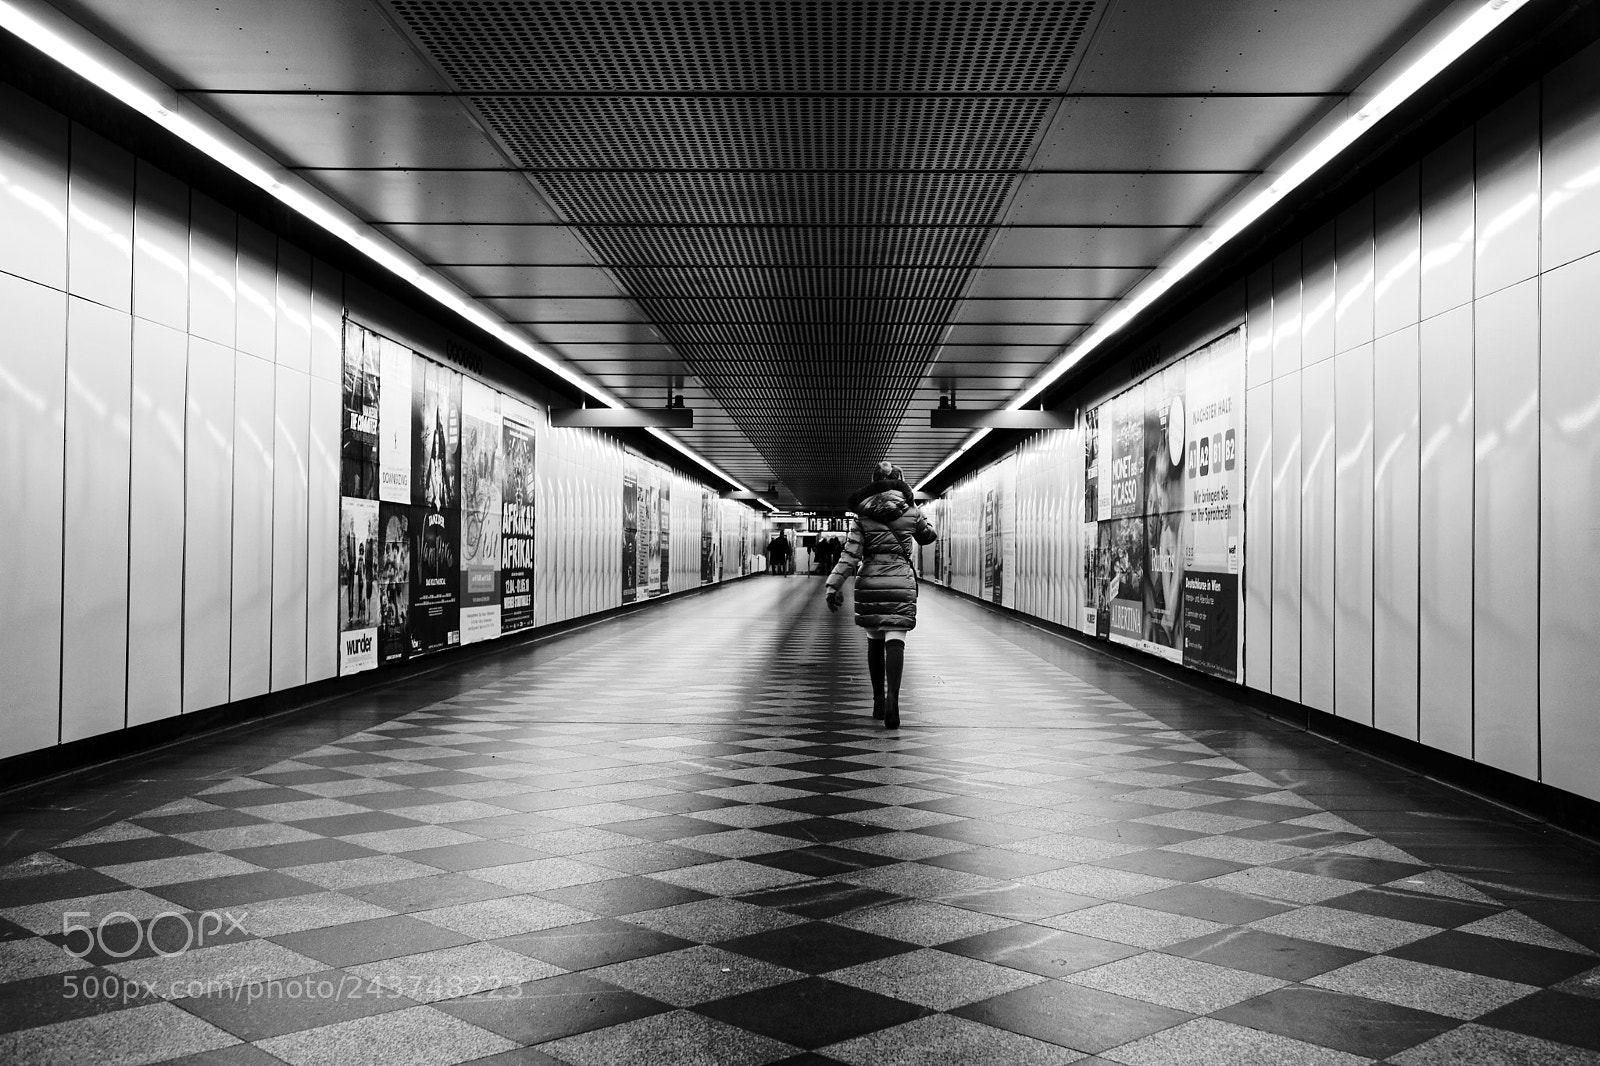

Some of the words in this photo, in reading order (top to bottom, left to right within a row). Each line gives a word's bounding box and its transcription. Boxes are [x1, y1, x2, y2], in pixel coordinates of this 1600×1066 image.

[1217, 397, 1233, 416] HALT:
[1189, 449, 1197, 470] A1
[1199, 445, 1209, 467] A2
[1213, 442, 1221, 464] B1
[1225, 438, 1235, 461] B2
[1112, 455, 1132, 482] MONET
[1112, 478, 1137, 506] PICASSO
[1193, 489, 1202, 505] Wir
[1202, 488, 1220, 506] bringen
[1220, 485, 1229, 501] Sie
[502, 502, 534, 537] AFRIKA!
[501, 537, 534, 569] AFRIKA!
[1151, 546, 1175, 573] Rubens
[1211, 580, 1222, 592] Wien
[1112, 605, 1142, 634] ALBERTINA
[346, 633, 372, 656] wunder
